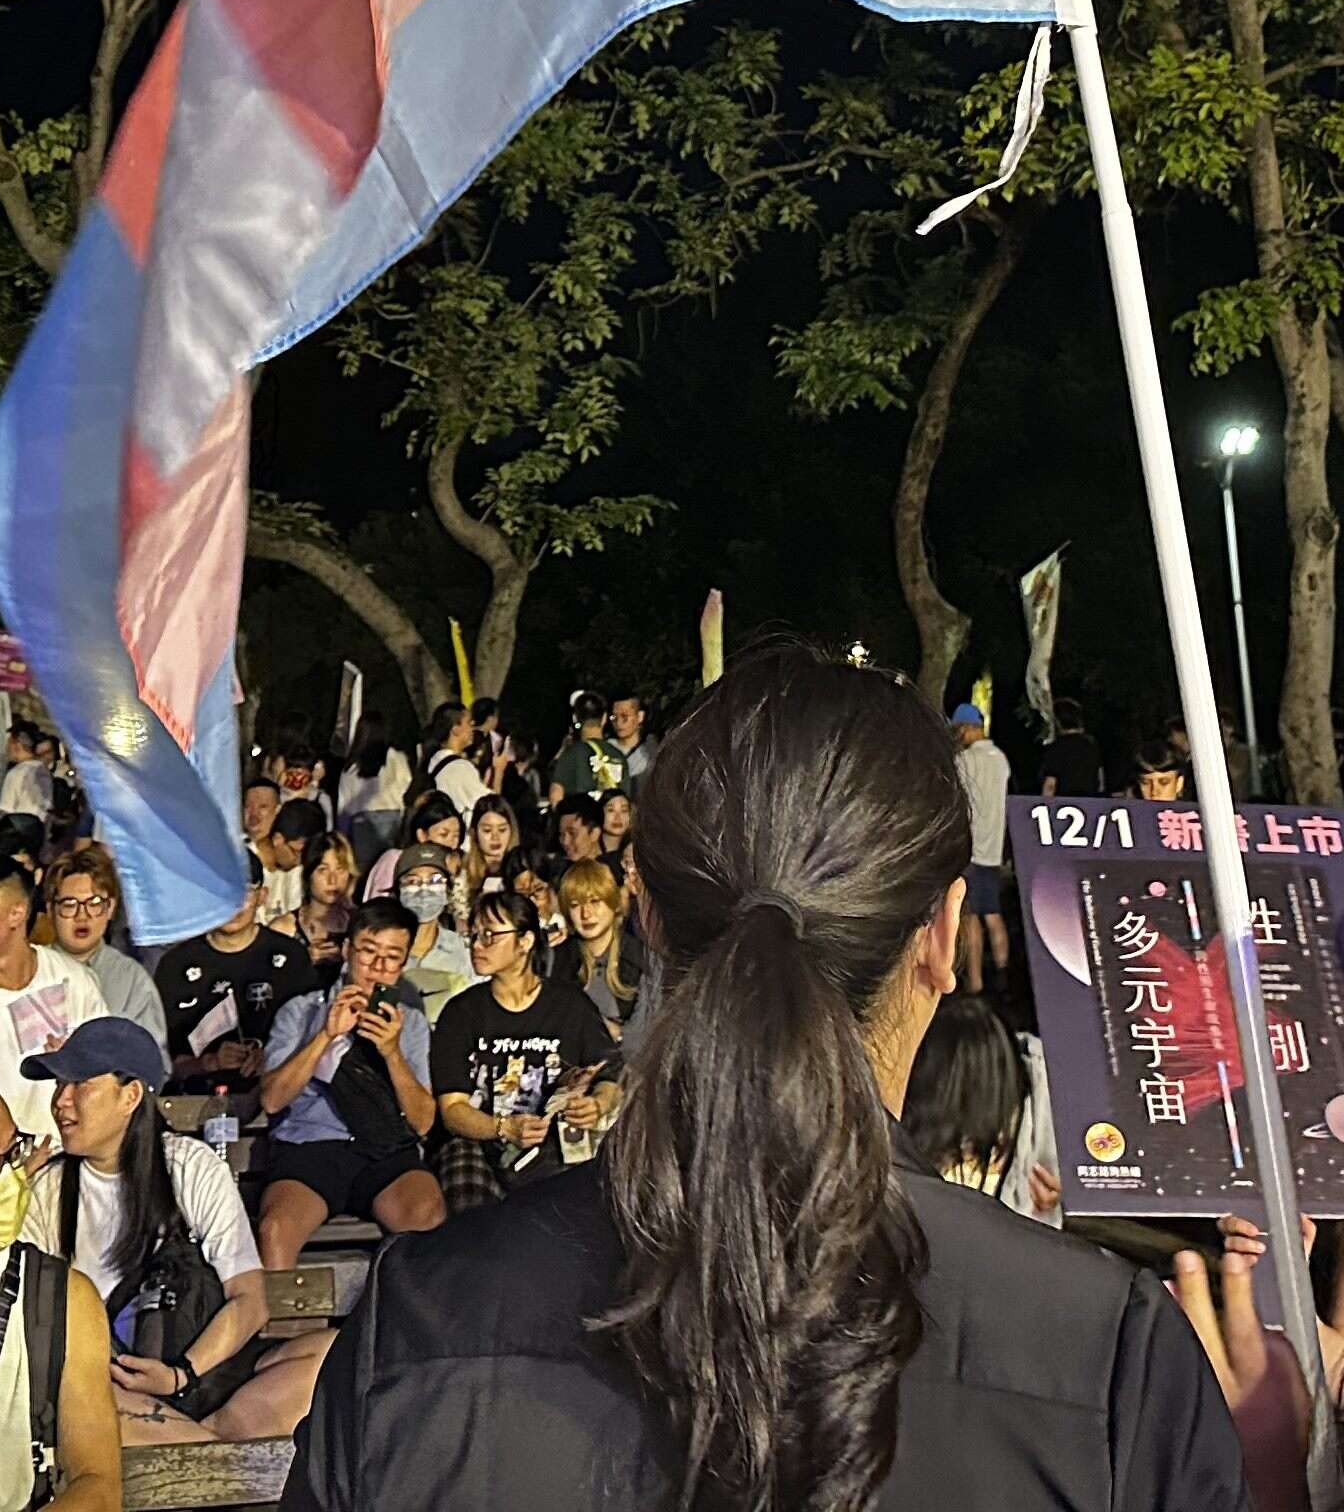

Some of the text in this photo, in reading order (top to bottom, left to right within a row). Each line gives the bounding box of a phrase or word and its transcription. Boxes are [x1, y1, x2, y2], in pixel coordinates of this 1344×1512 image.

[1031, 805, 1134, 849] 12/1
[1113, 911, 1187, 1125] 多元宇宙
